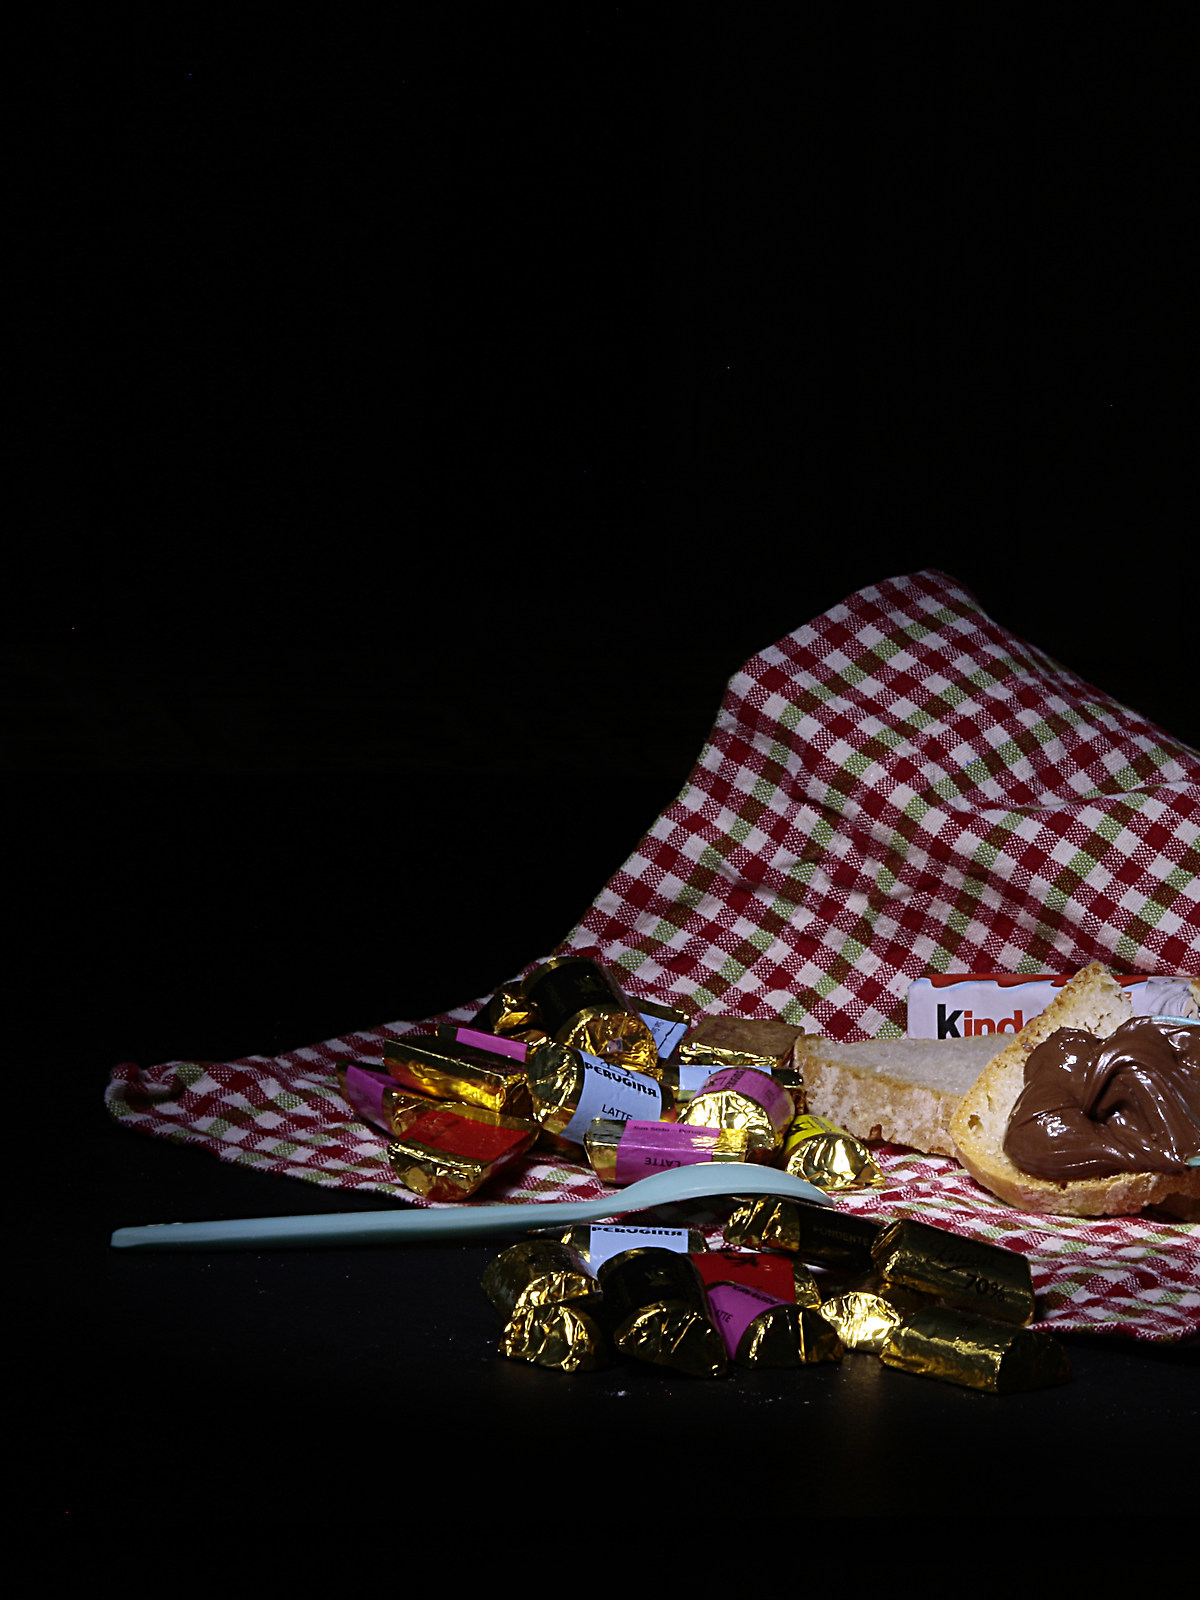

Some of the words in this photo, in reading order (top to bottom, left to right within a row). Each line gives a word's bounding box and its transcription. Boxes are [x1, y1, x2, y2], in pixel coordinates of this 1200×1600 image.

[584, 1061, 658, 1098] PERUGINA
[602, 1104, 633, 1120] LATTE
[644, 1156, 681, 1168] LATTE
[963, 1272, 1006, 1303] 70%
